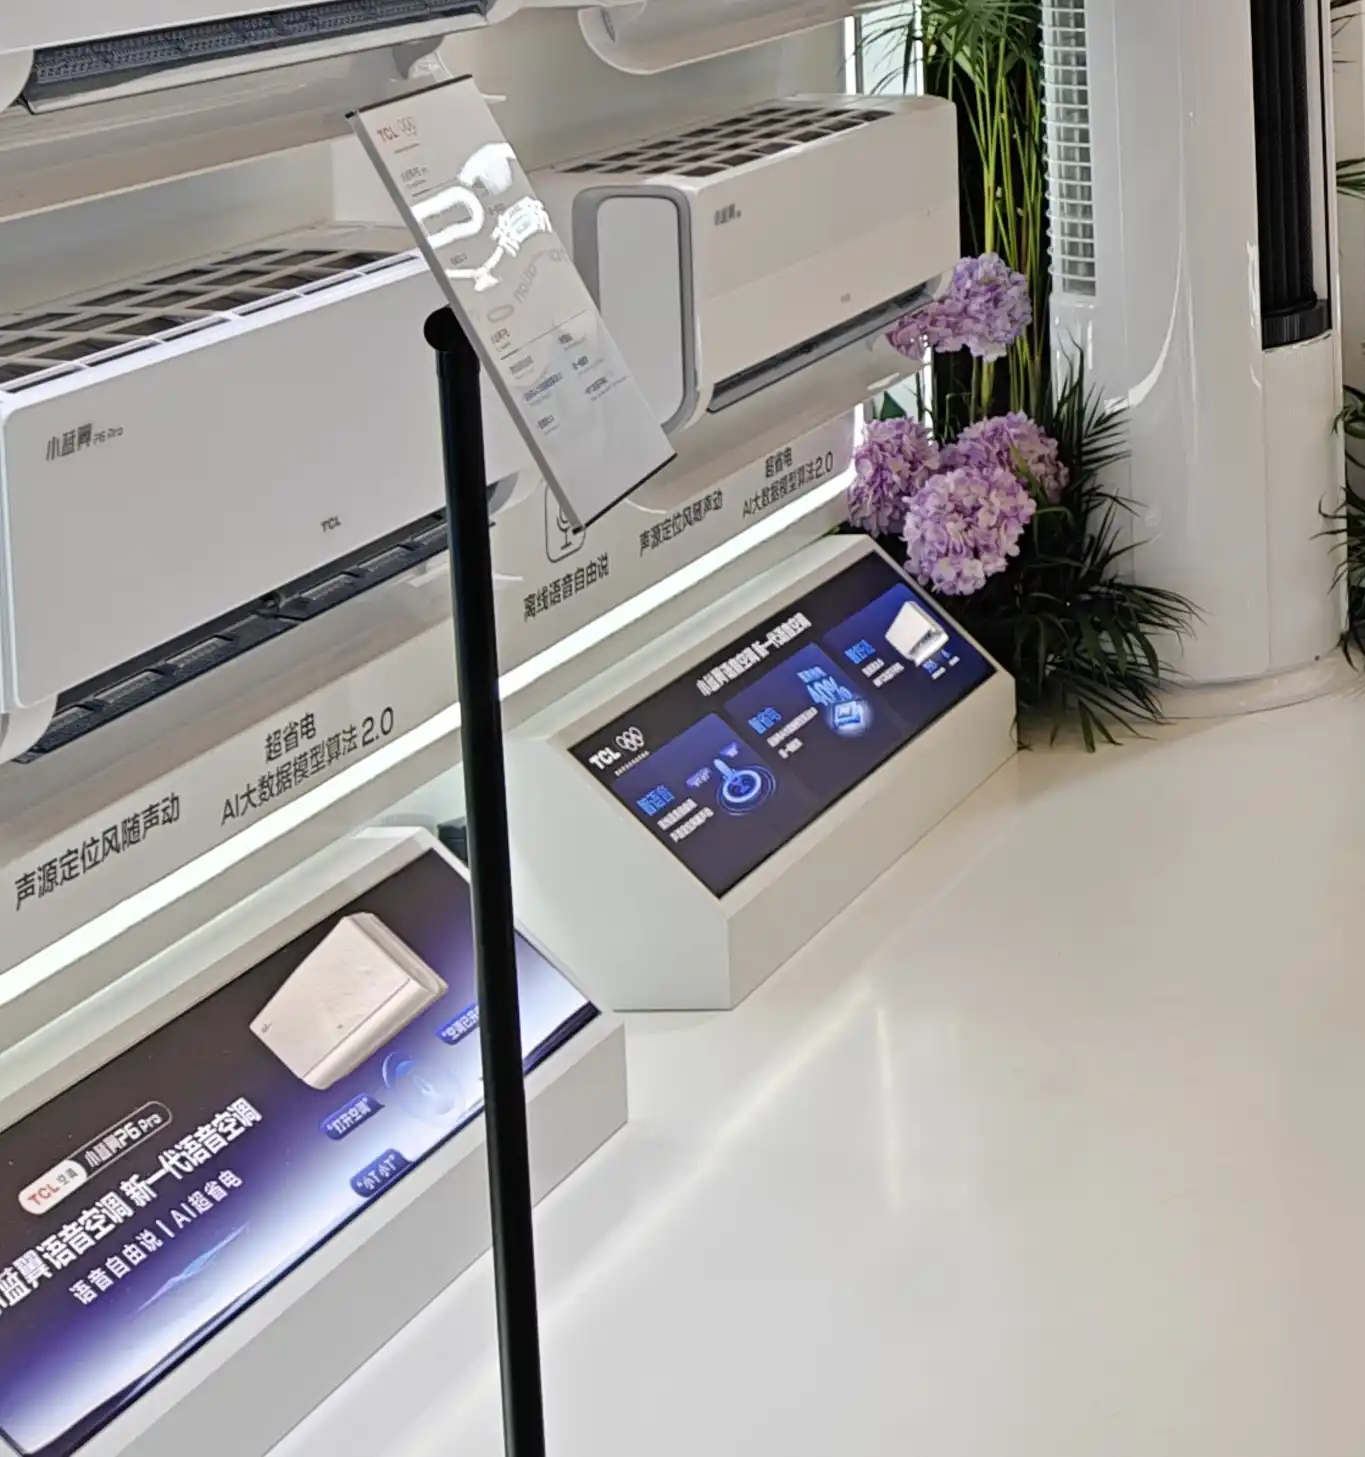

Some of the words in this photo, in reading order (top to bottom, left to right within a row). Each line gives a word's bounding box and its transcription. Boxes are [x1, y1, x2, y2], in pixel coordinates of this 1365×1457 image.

[742, 451, 834, 519] AI大数据模型算法2.0
[765, 446, 793, 478] 超省电
[320, 515, 341, 533] TCL
[640, 489, 723, 557] 声源定位风随声动
[523, 552, 609, 622] 离线语音自由说
[220, 706, 394, 826] AI大数据模型算法2.0
[264, 712, 316, 763] 超省电
[587, 744, 622, 771] TCL
[14, 792, 181, 911] 声源定位风随声动
[27, 1182, 61, 1207] TCL
[138, 1113, 163, 1134] Pro
[120, 1097, 263, 1207] 新一代语音空调
[69, 1229, 164, 1305] 语音自由说
[171, 1168, 244, 1230] AI超省电
